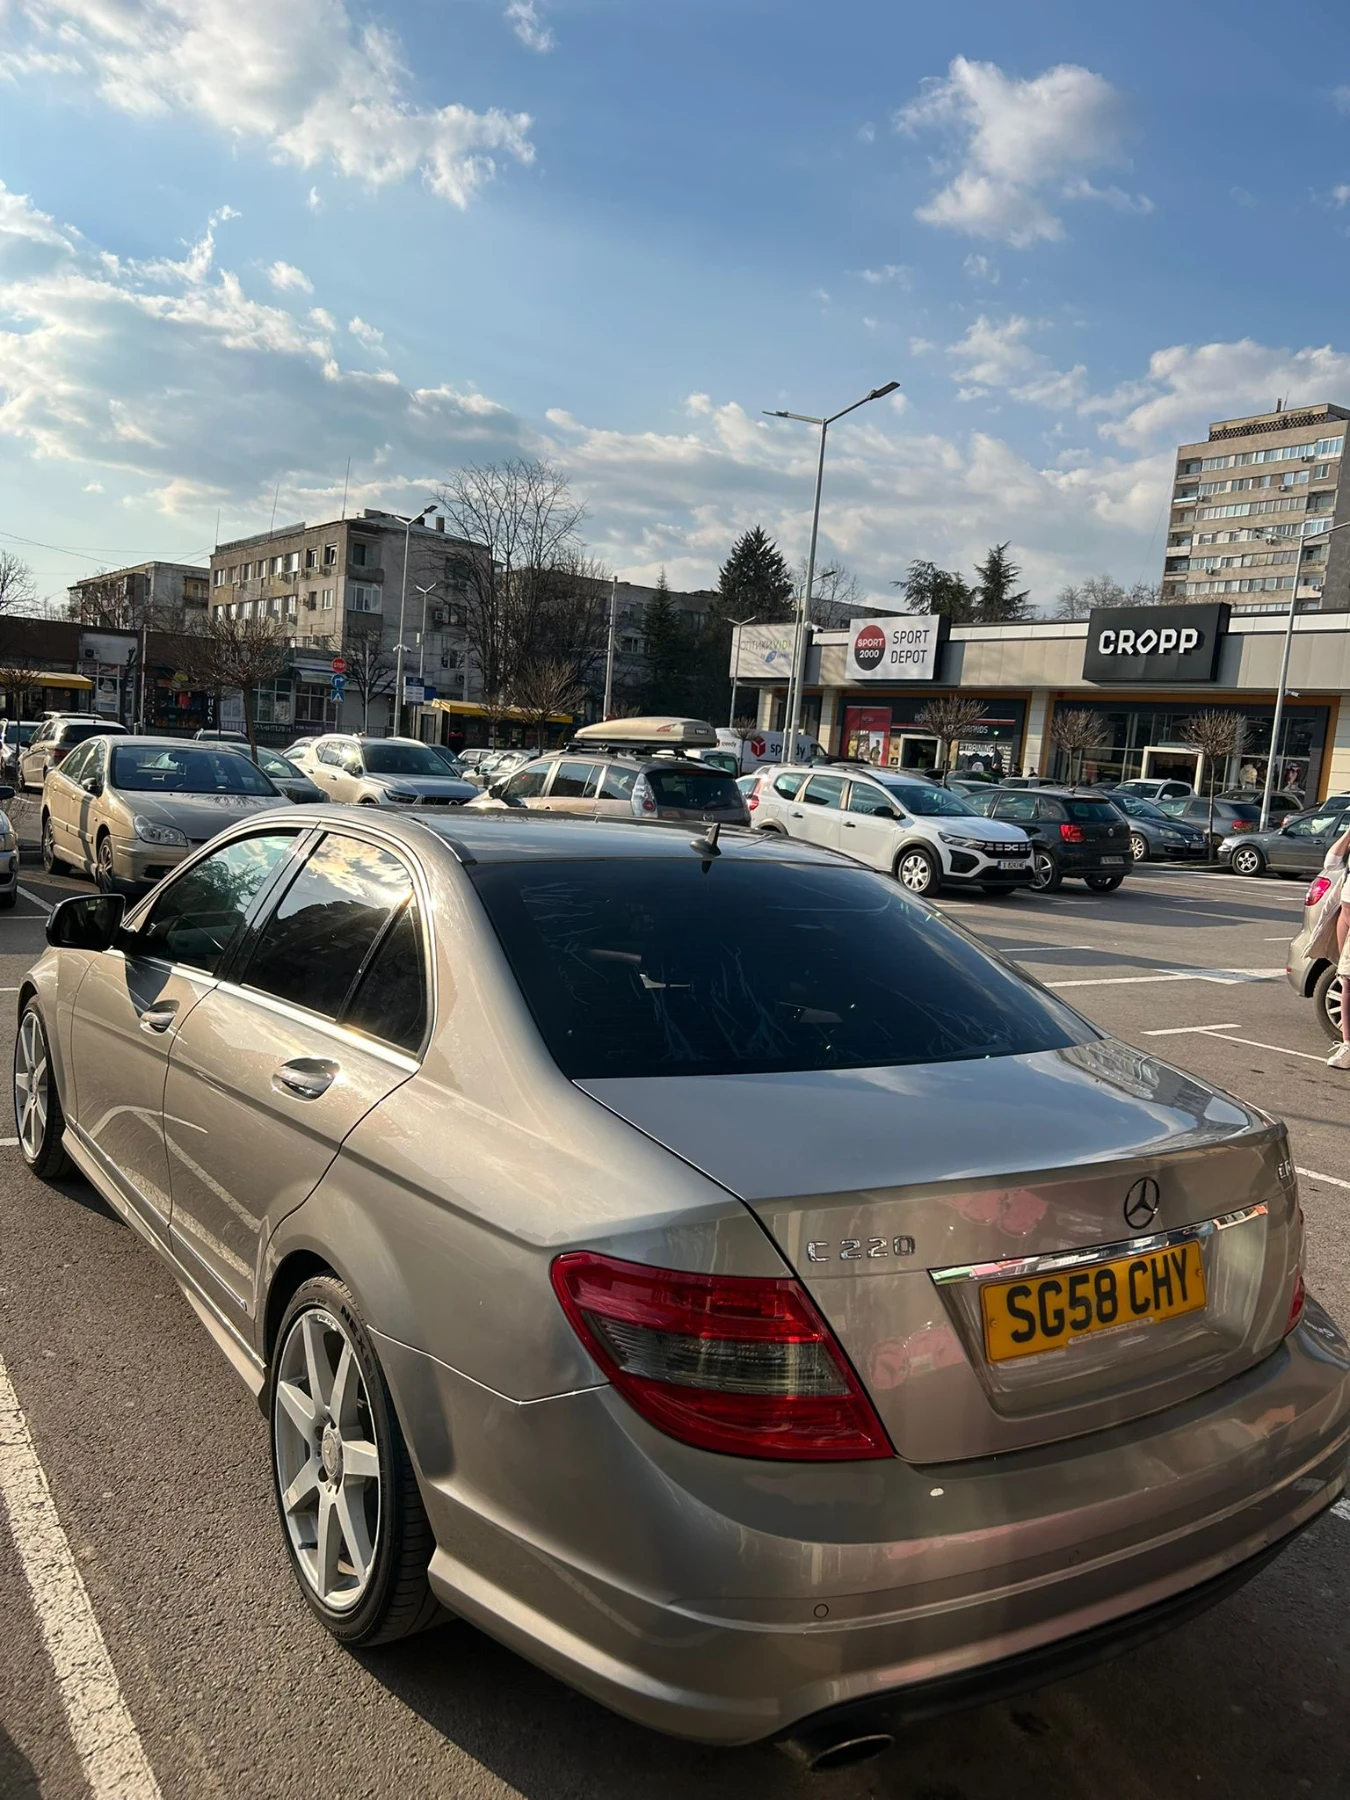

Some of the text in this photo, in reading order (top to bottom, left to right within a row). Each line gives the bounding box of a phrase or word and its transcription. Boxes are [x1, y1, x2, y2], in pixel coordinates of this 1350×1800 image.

[857, 637, 884, 647] SPORT
[892, 630, 930, 645] SPORT
[1098, 628, 1198, 655] CROPP
[859, 649, 880, 658] 2000
[891, 650, 928, 664] DEPOT
[770, 743, 806, 759] spdy
[964, 743, 994, 752] TRAINING
[807, 1235, 916, 1262] C 220
[1006, 1268, 1119, 1344] SG58
[1128, 1248, 1188, 1315] CHY
